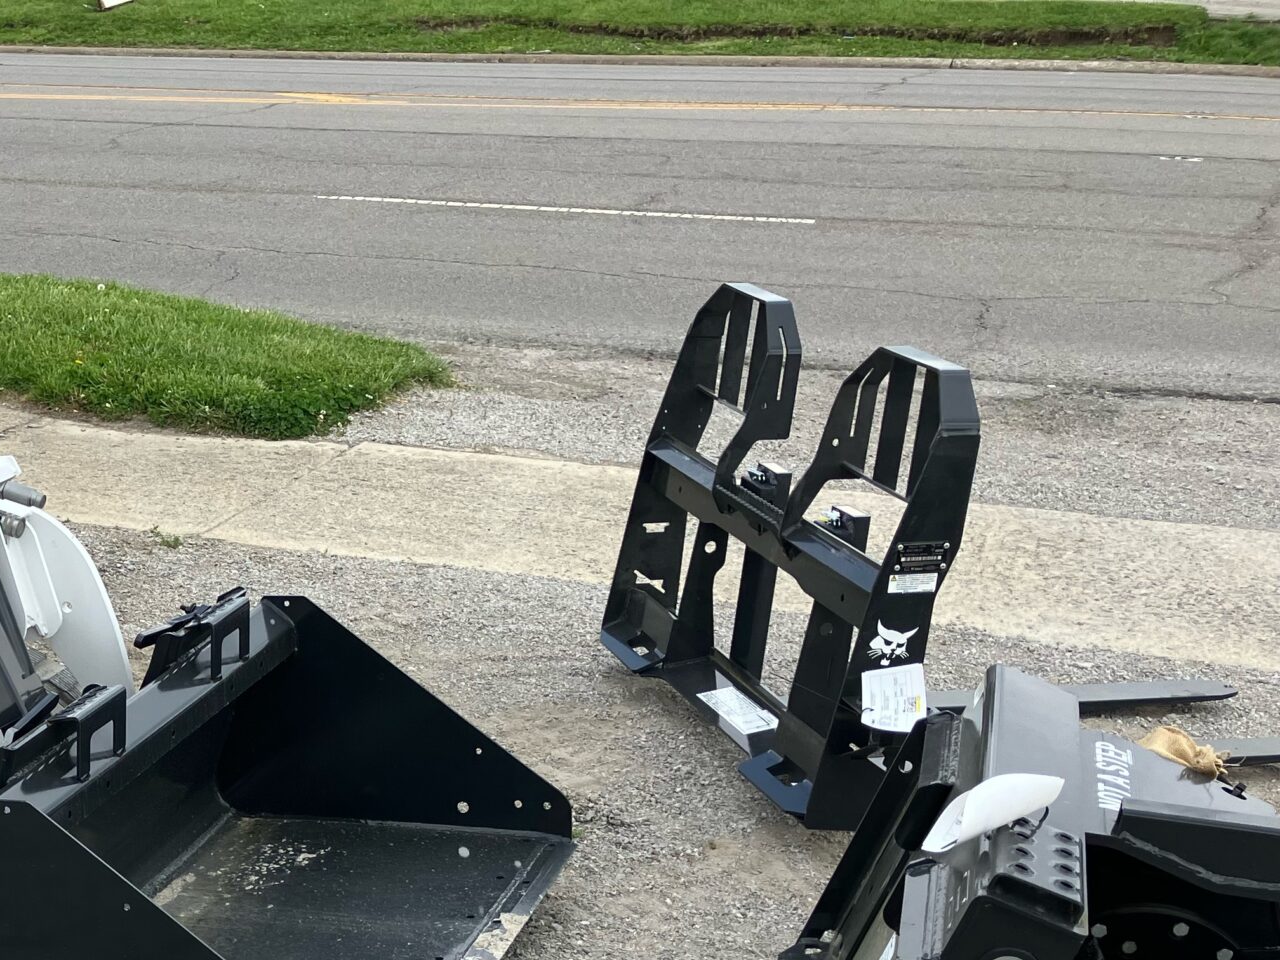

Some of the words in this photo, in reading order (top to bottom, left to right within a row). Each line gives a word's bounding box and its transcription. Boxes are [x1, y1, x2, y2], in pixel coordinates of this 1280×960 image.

[1095, 741, 1131, 777] STEP
[1096, 773, 1131, 790] A
[1097, 782, 1132, 812] NOT
